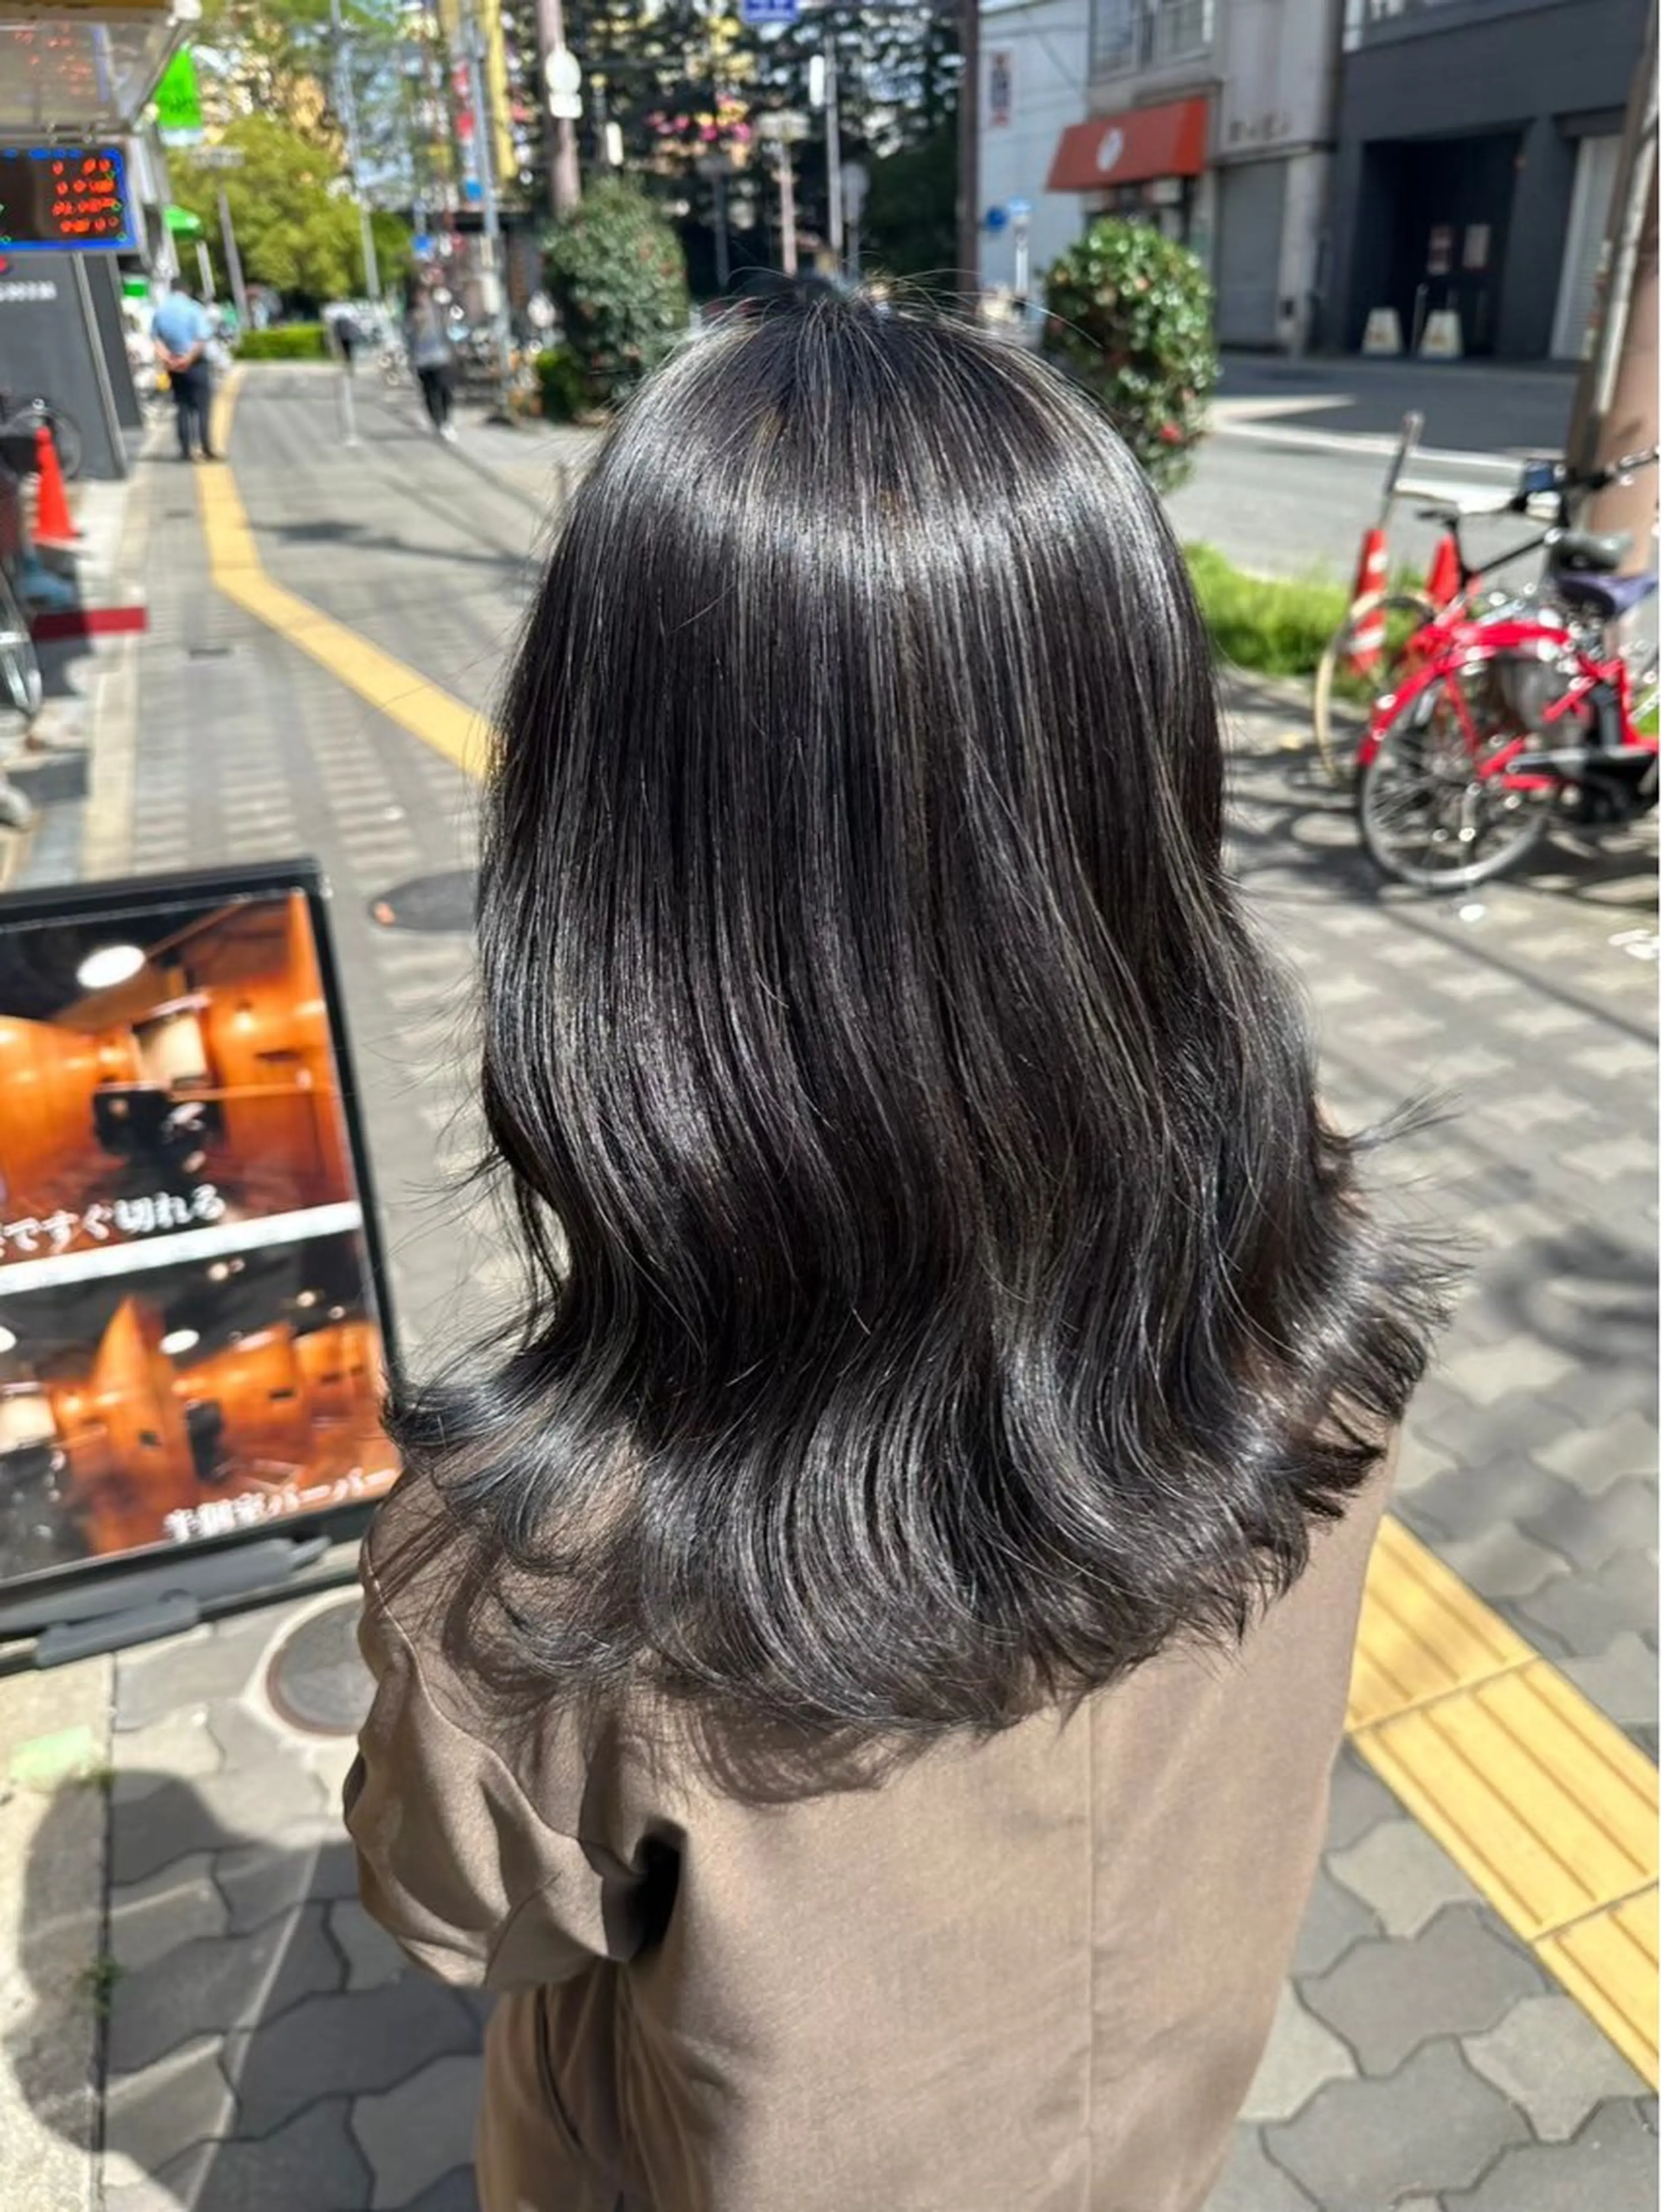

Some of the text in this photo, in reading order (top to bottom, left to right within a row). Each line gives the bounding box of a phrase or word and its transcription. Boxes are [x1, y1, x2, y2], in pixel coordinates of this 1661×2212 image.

[0, 1184, 226, 1257] ですぐ切れる
